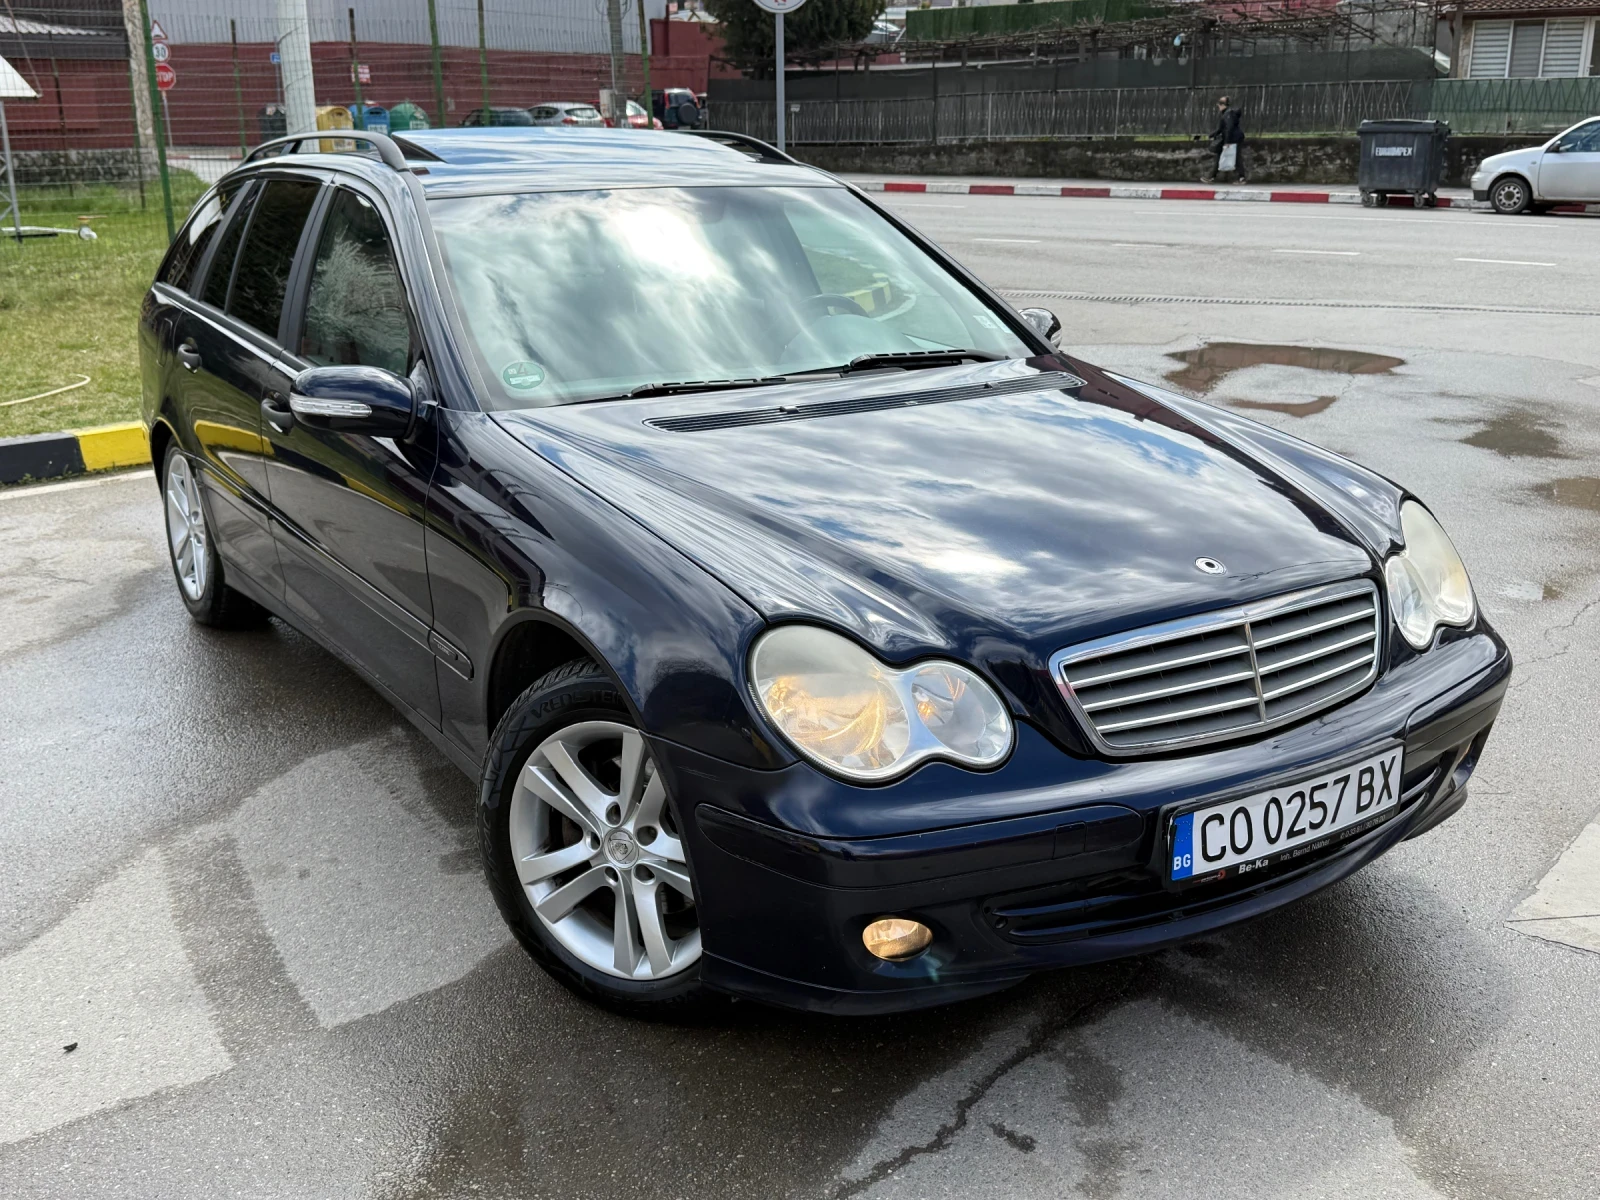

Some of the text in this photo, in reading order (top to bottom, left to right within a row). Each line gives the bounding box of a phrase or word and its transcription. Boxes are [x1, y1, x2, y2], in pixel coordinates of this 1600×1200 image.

[155, 46, 167, 58] 30
[1201, 755, 1396, 863] CO 0257 BX
[1173, 853, 1191, 870] BG
